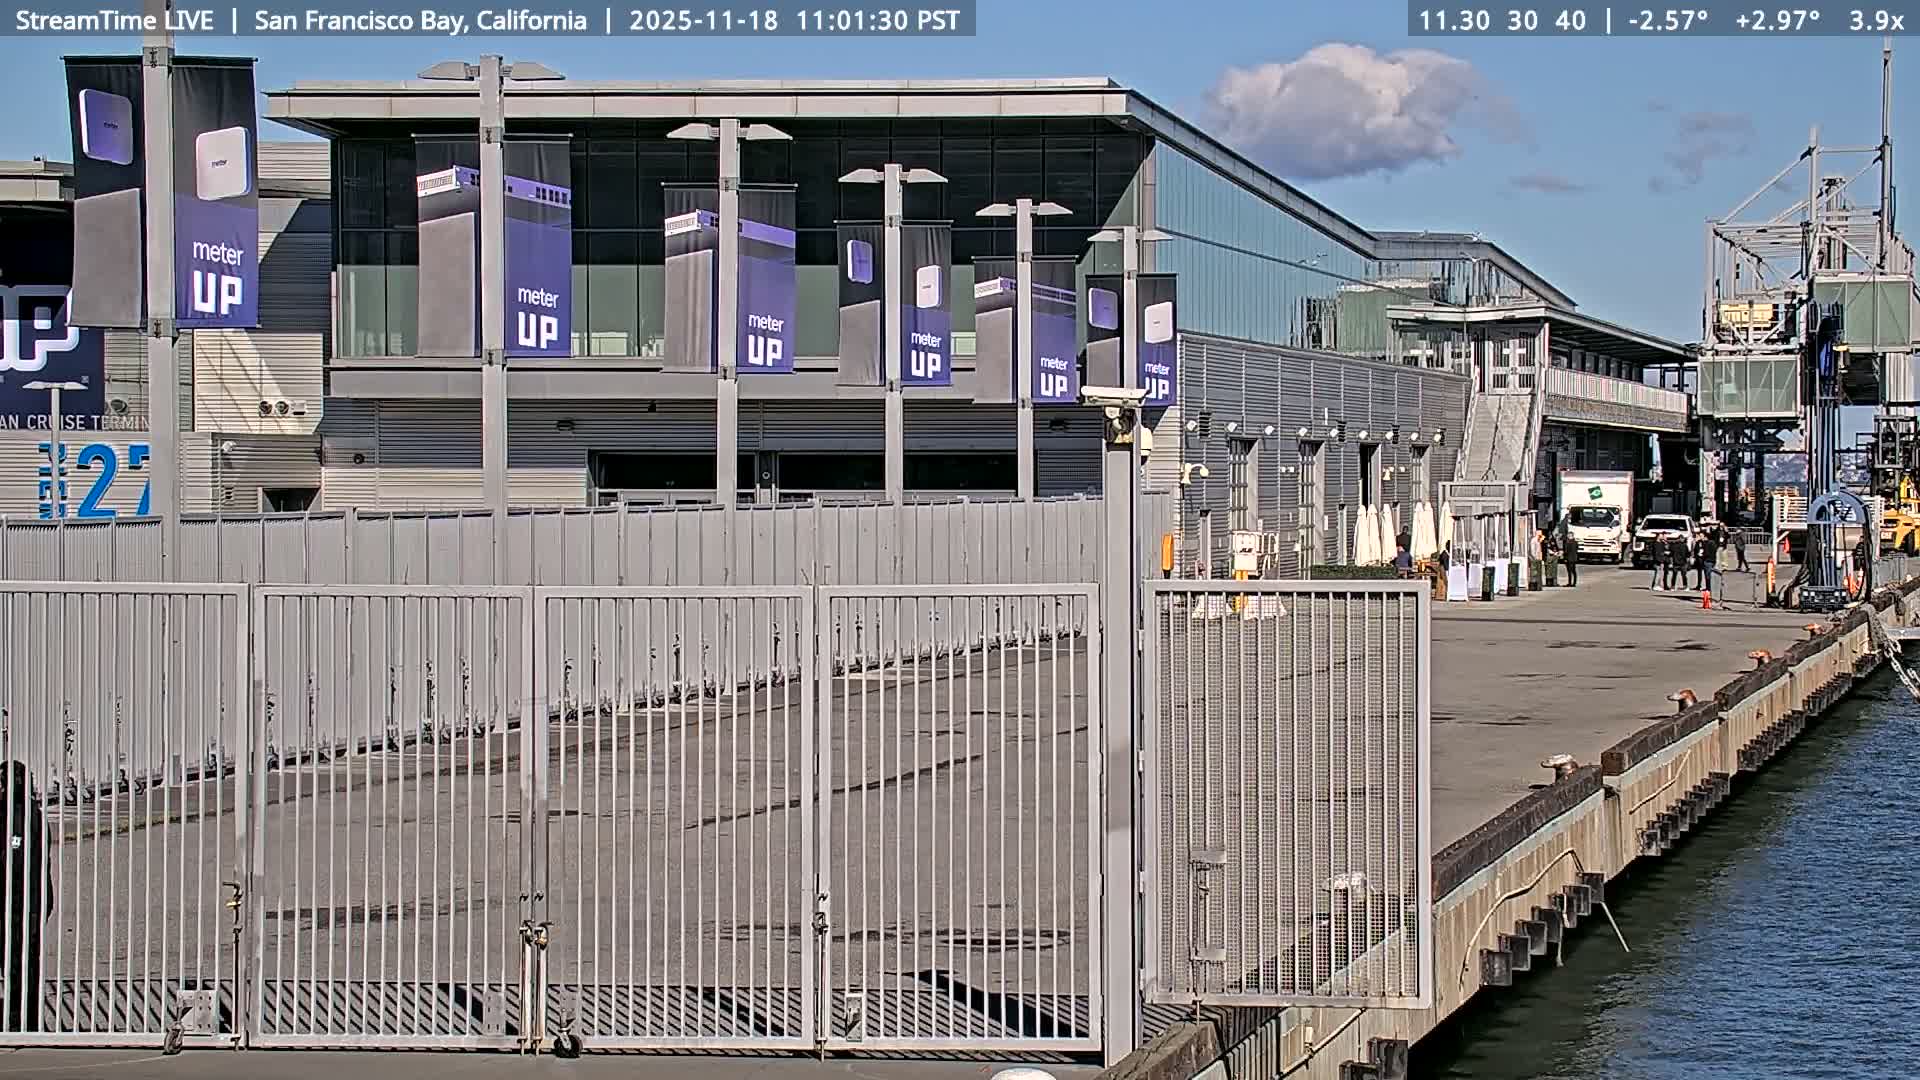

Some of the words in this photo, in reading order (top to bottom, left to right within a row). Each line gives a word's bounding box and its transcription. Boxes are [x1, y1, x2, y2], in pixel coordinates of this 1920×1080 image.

[193, 240, 244, 266] meter
[193, 270, 243, 315] UP
[518, 287, 559, 308] meter
[518, 311, 559, 349] UP
[748, 314, 785, 333] meter
[748, 334, 783, 366] UP
[911, 332, 942, 348] meter
[911, 350, 941, 378] UP
[1040, 356, 1068, 371] meter
[1144, 362, 1170, 376] meter
[1040, 373, 1068, 397] UP
[1144, 377, 1170, 400] UP
